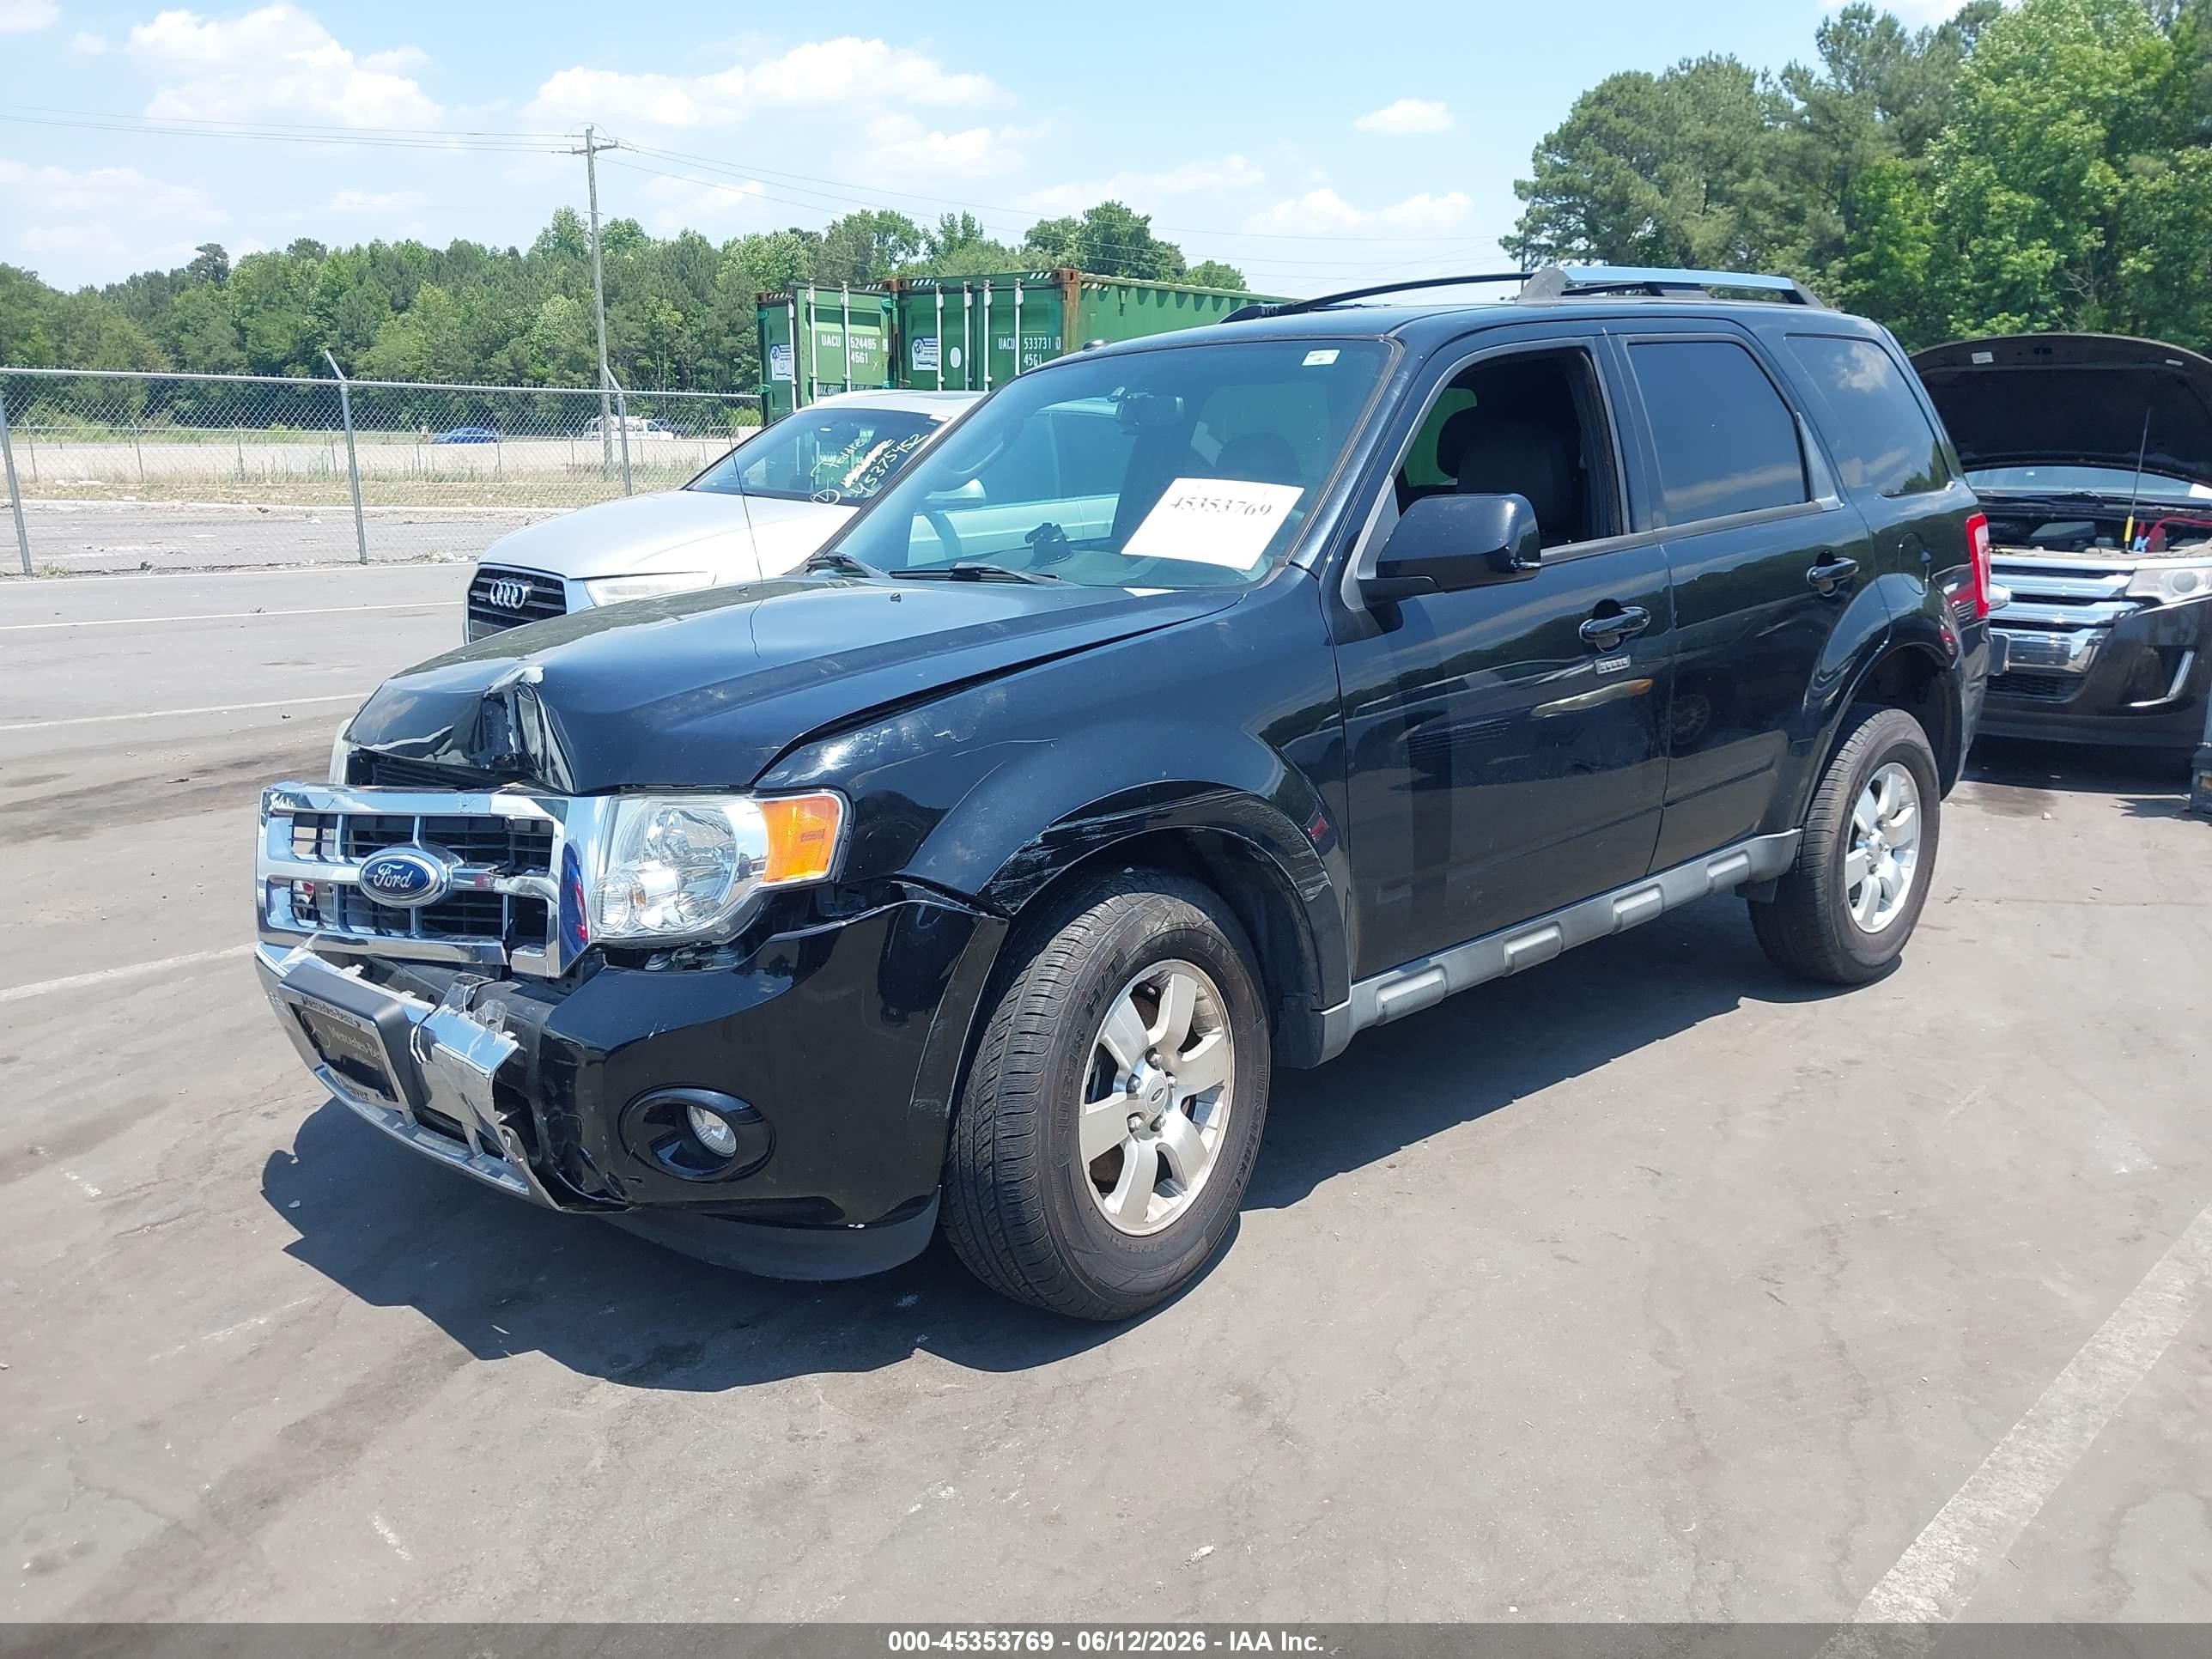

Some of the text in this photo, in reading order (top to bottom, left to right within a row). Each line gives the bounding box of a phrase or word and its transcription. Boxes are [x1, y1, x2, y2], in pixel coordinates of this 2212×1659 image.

[821, 334, 841, 348] UACU
[998, 337, 1061, 351] UACU 533731 0
[850, 351, 869, 364] 45G1
[1023, 353, 1042, 367] 45G1
[849, 433, 930, 494] 45375452
[1170, 496, 1273, 516] 45353769
[373, 862, 414, 890] Ford
